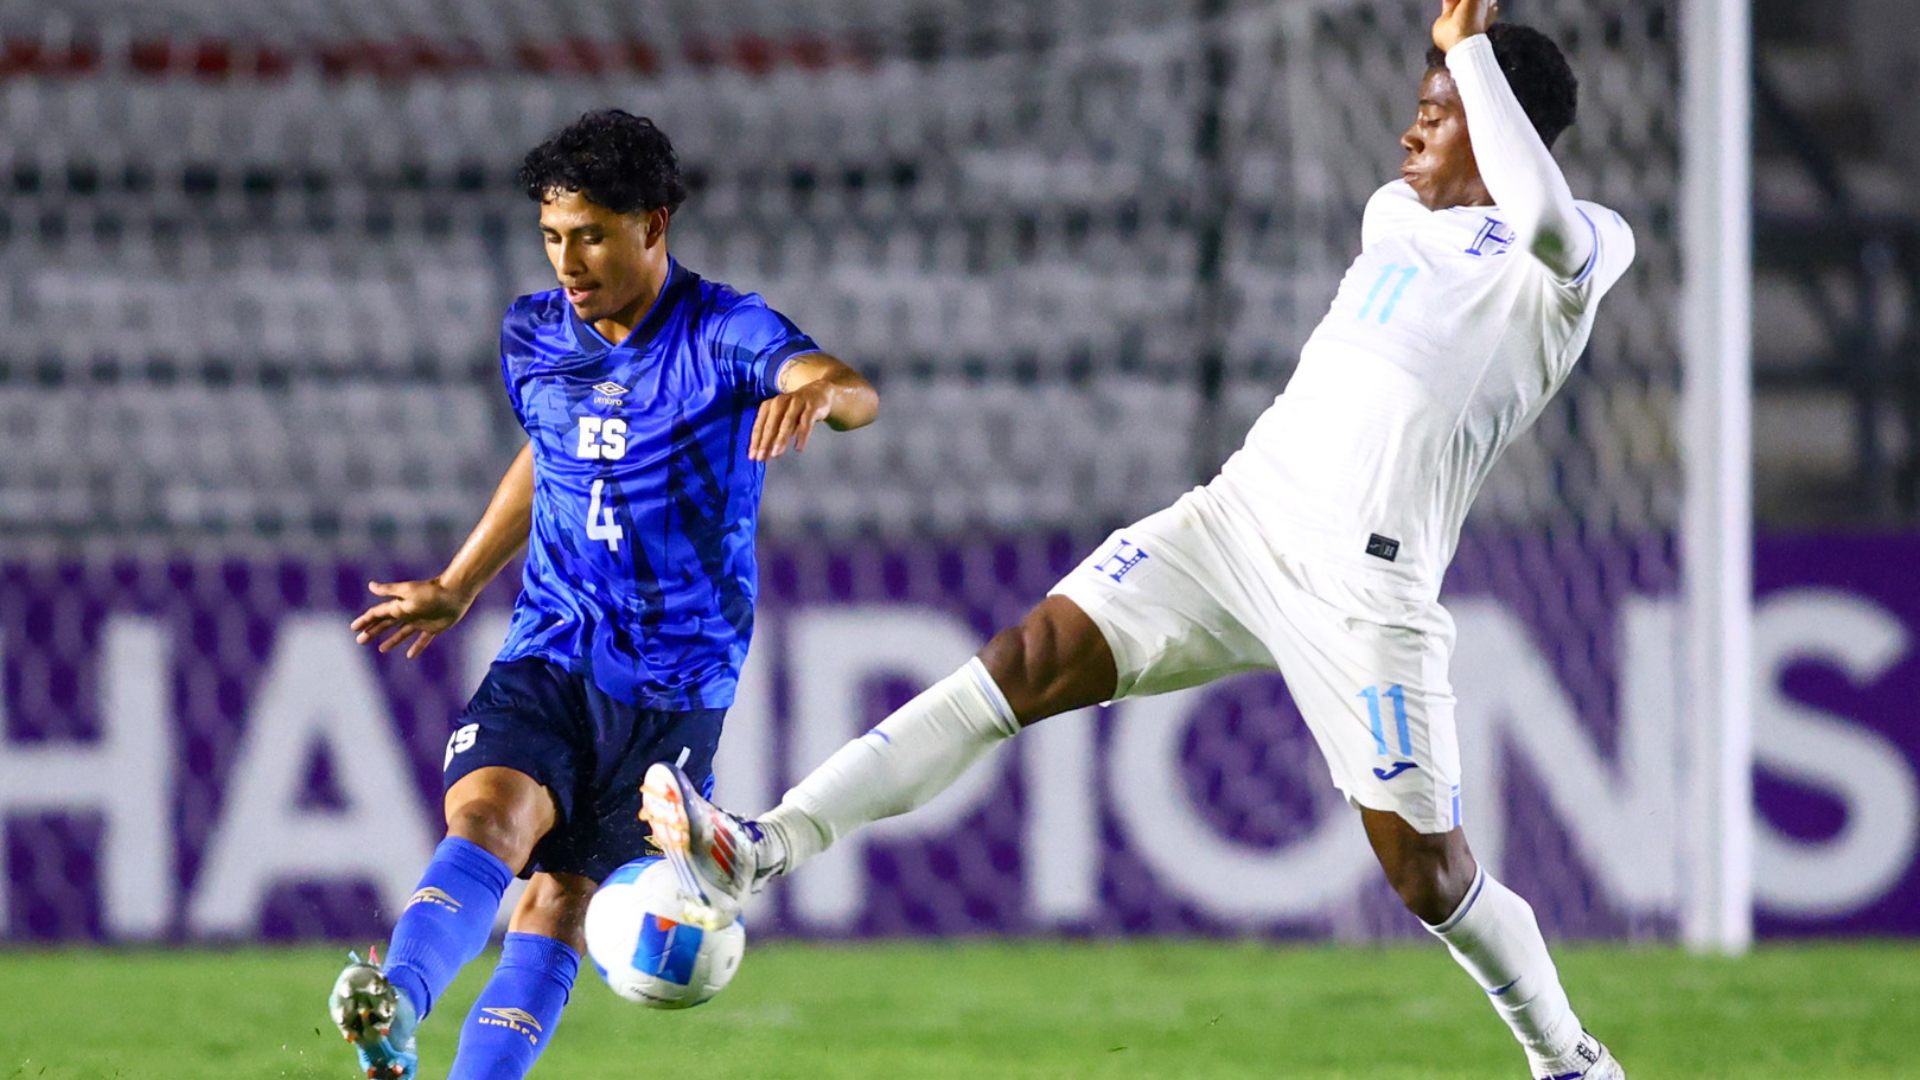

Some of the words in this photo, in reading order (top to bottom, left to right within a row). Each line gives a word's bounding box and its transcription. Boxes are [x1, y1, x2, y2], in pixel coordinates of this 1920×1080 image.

[1357, 262, 1419, 324] 11
[576, 416, 628, 461] ES
[585, 479, 624, 552] 4
[1356, 683, 1413, 758] 11
[0, 585, 1920, 938] HAPIONS
[478, 1016, 538, 1046] umbro
